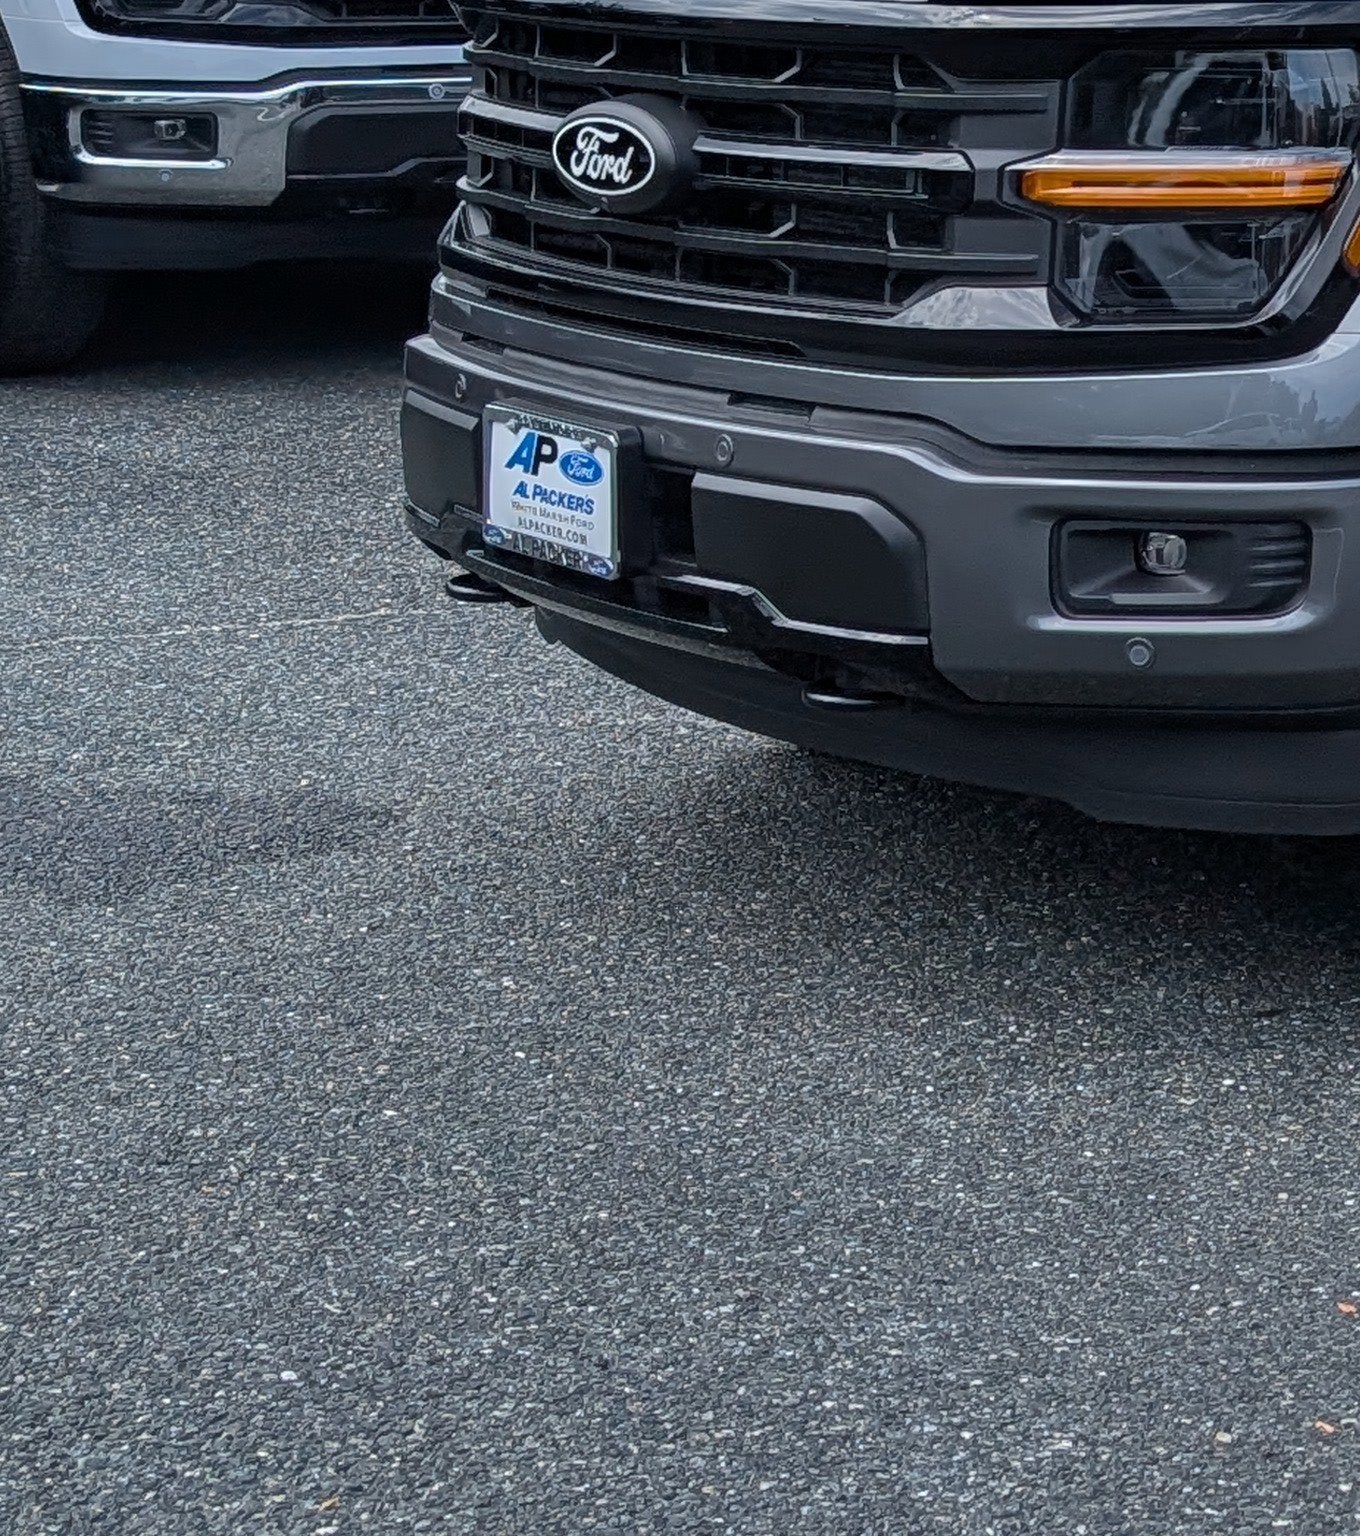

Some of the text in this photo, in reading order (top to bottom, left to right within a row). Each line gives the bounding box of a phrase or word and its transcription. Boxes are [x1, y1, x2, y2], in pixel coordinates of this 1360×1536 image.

[570, 126, 635, 184] Ford
[505, 431, 559, 476] AP
[569, 453, 596, 480] Ford
[513, 480, 595, 515] AL PACKER'S
